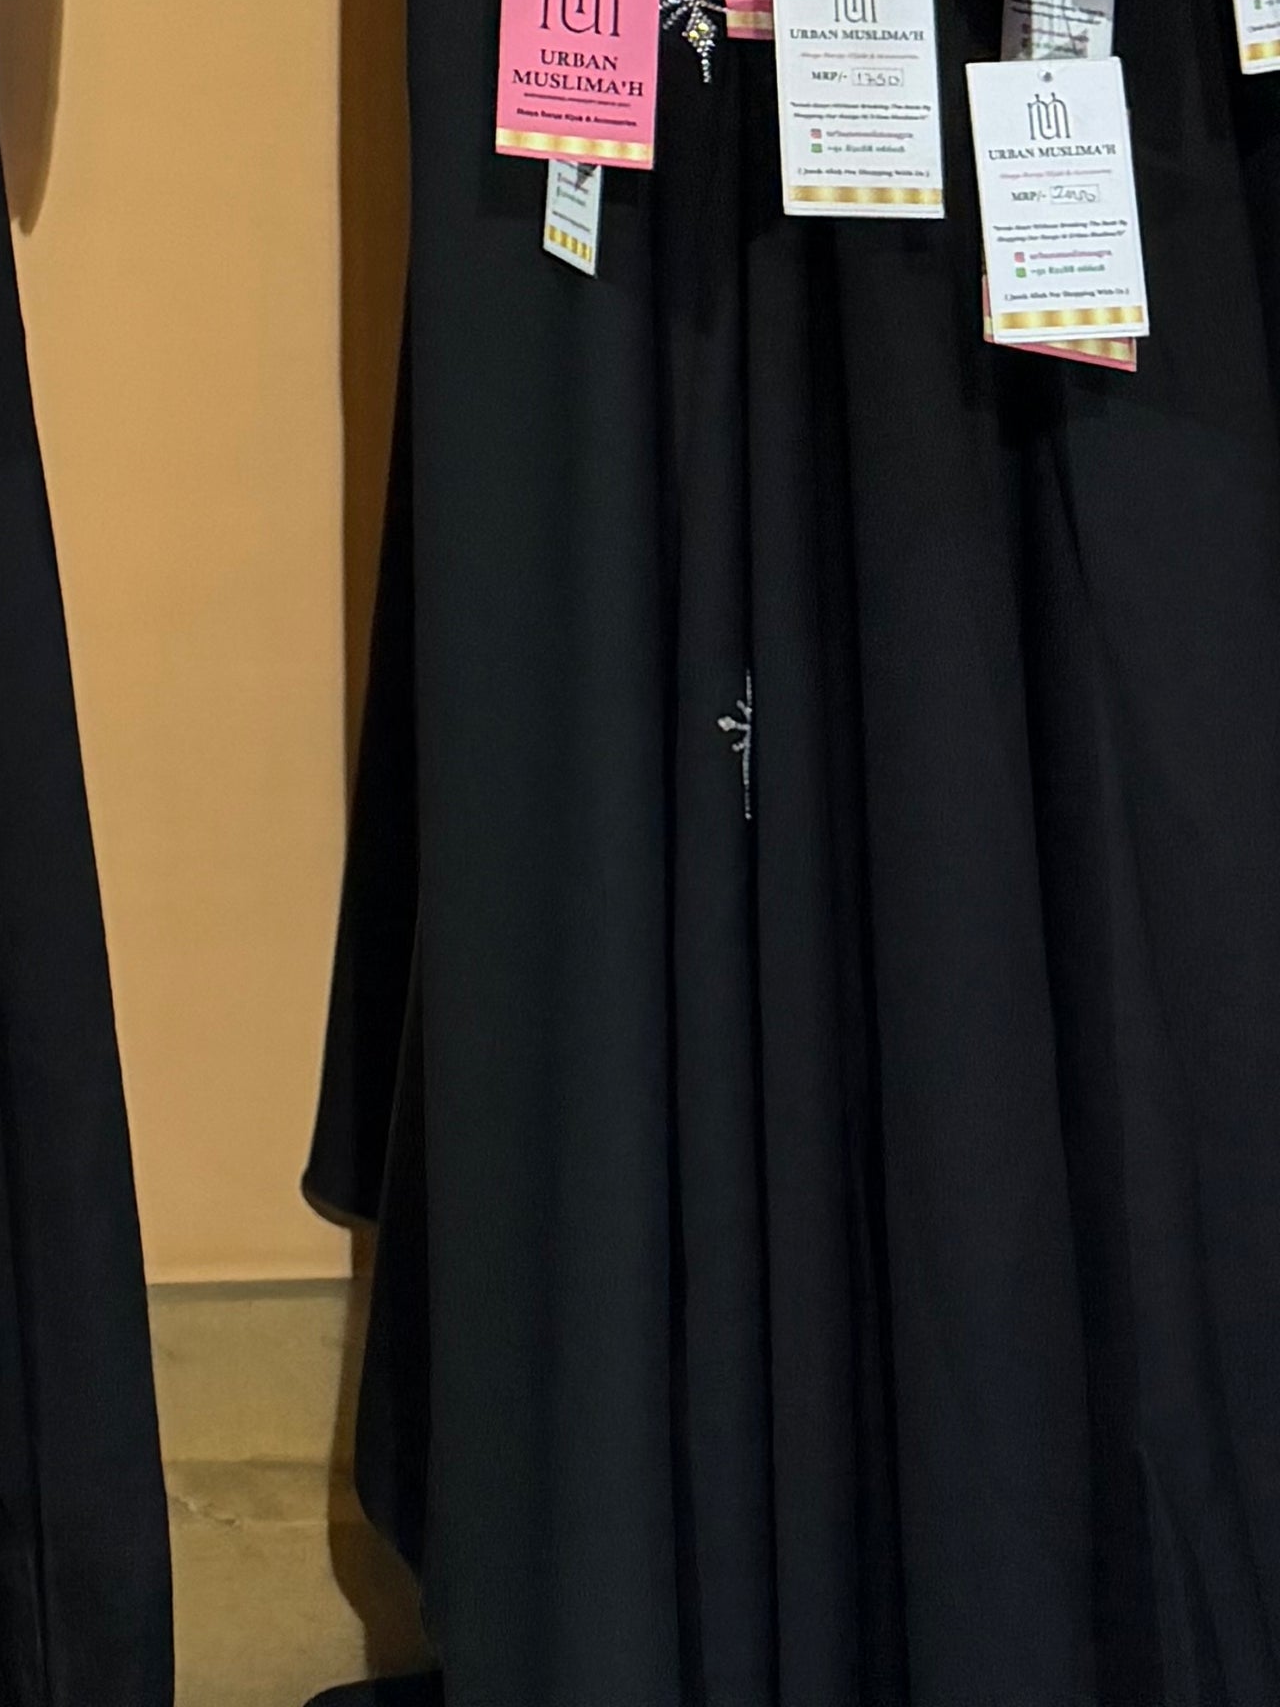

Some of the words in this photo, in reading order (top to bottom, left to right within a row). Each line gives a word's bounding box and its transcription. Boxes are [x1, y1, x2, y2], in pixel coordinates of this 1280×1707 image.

[790, 28, 839, 40] URBAN
[841, 29, 924, 41] MUSLIMA'H
[540, 48, 619, 71] URBAN
[512, 68, 644, 97] MUSLIMA'H
[988, 147, 1036, 161] URBAN
[1037, 144, 1116, 158] MUSLIMA'H
